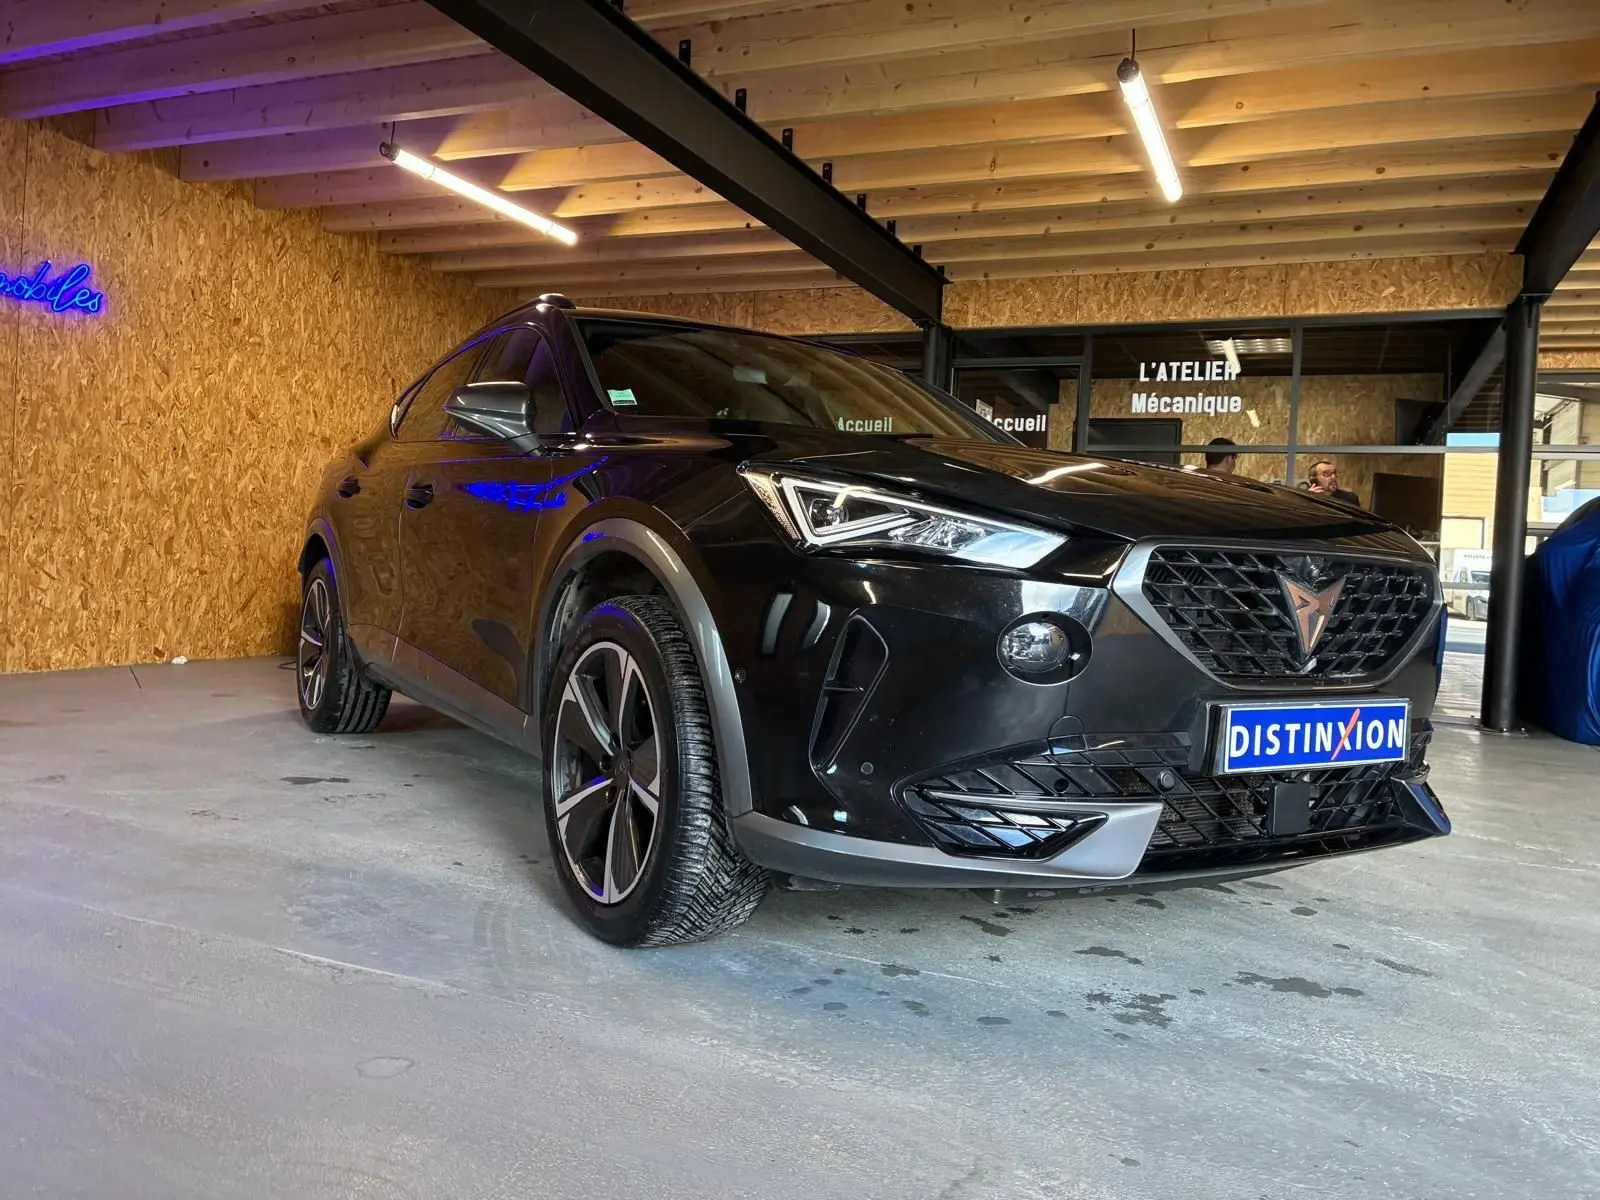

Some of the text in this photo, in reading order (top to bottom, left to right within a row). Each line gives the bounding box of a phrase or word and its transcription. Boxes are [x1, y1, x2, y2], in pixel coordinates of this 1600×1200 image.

[1140, 361, 1237, 381] L'ATELIER
[1131, 393, 1242, 416] Mécanique
[837, 416, 892, 432] Accueil
[1230, 710, 1404, 761] DISTINXION
